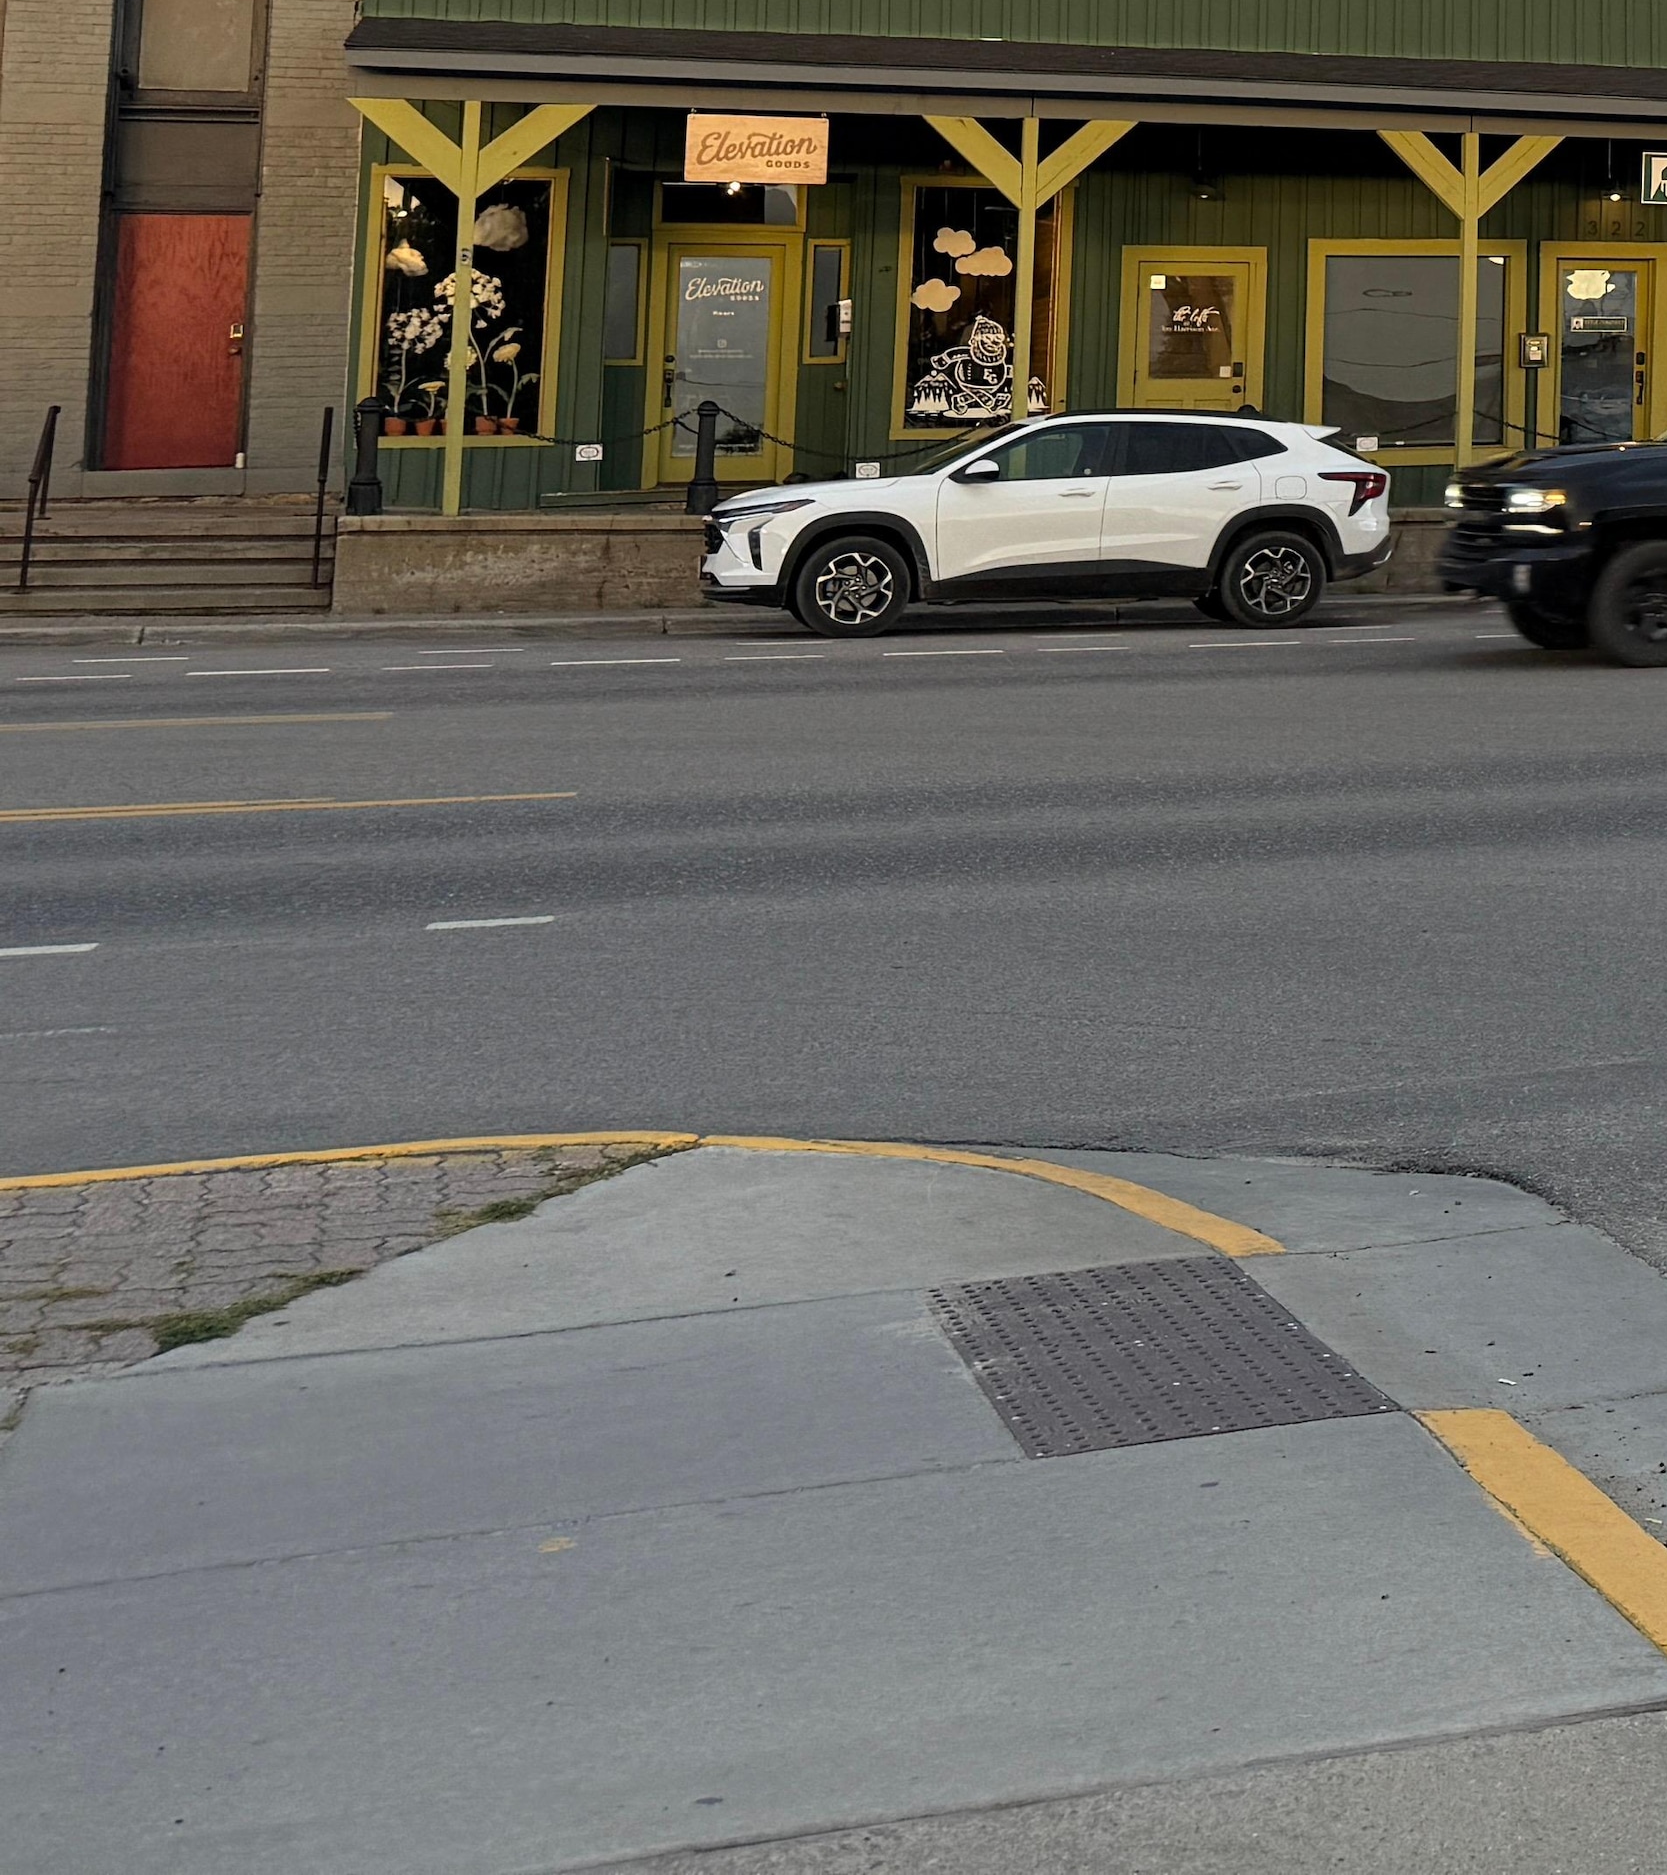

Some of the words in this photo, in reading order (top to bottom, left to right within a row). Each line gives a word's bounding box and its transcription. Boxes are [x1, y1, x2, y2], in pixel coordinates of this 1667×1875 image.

[696, 131, 818, 166] Elevation
[766, 159, 811, 169] GOODS
[1587, 220, 1646, 237] 322
[685, 277, 764, 301] Elevation
